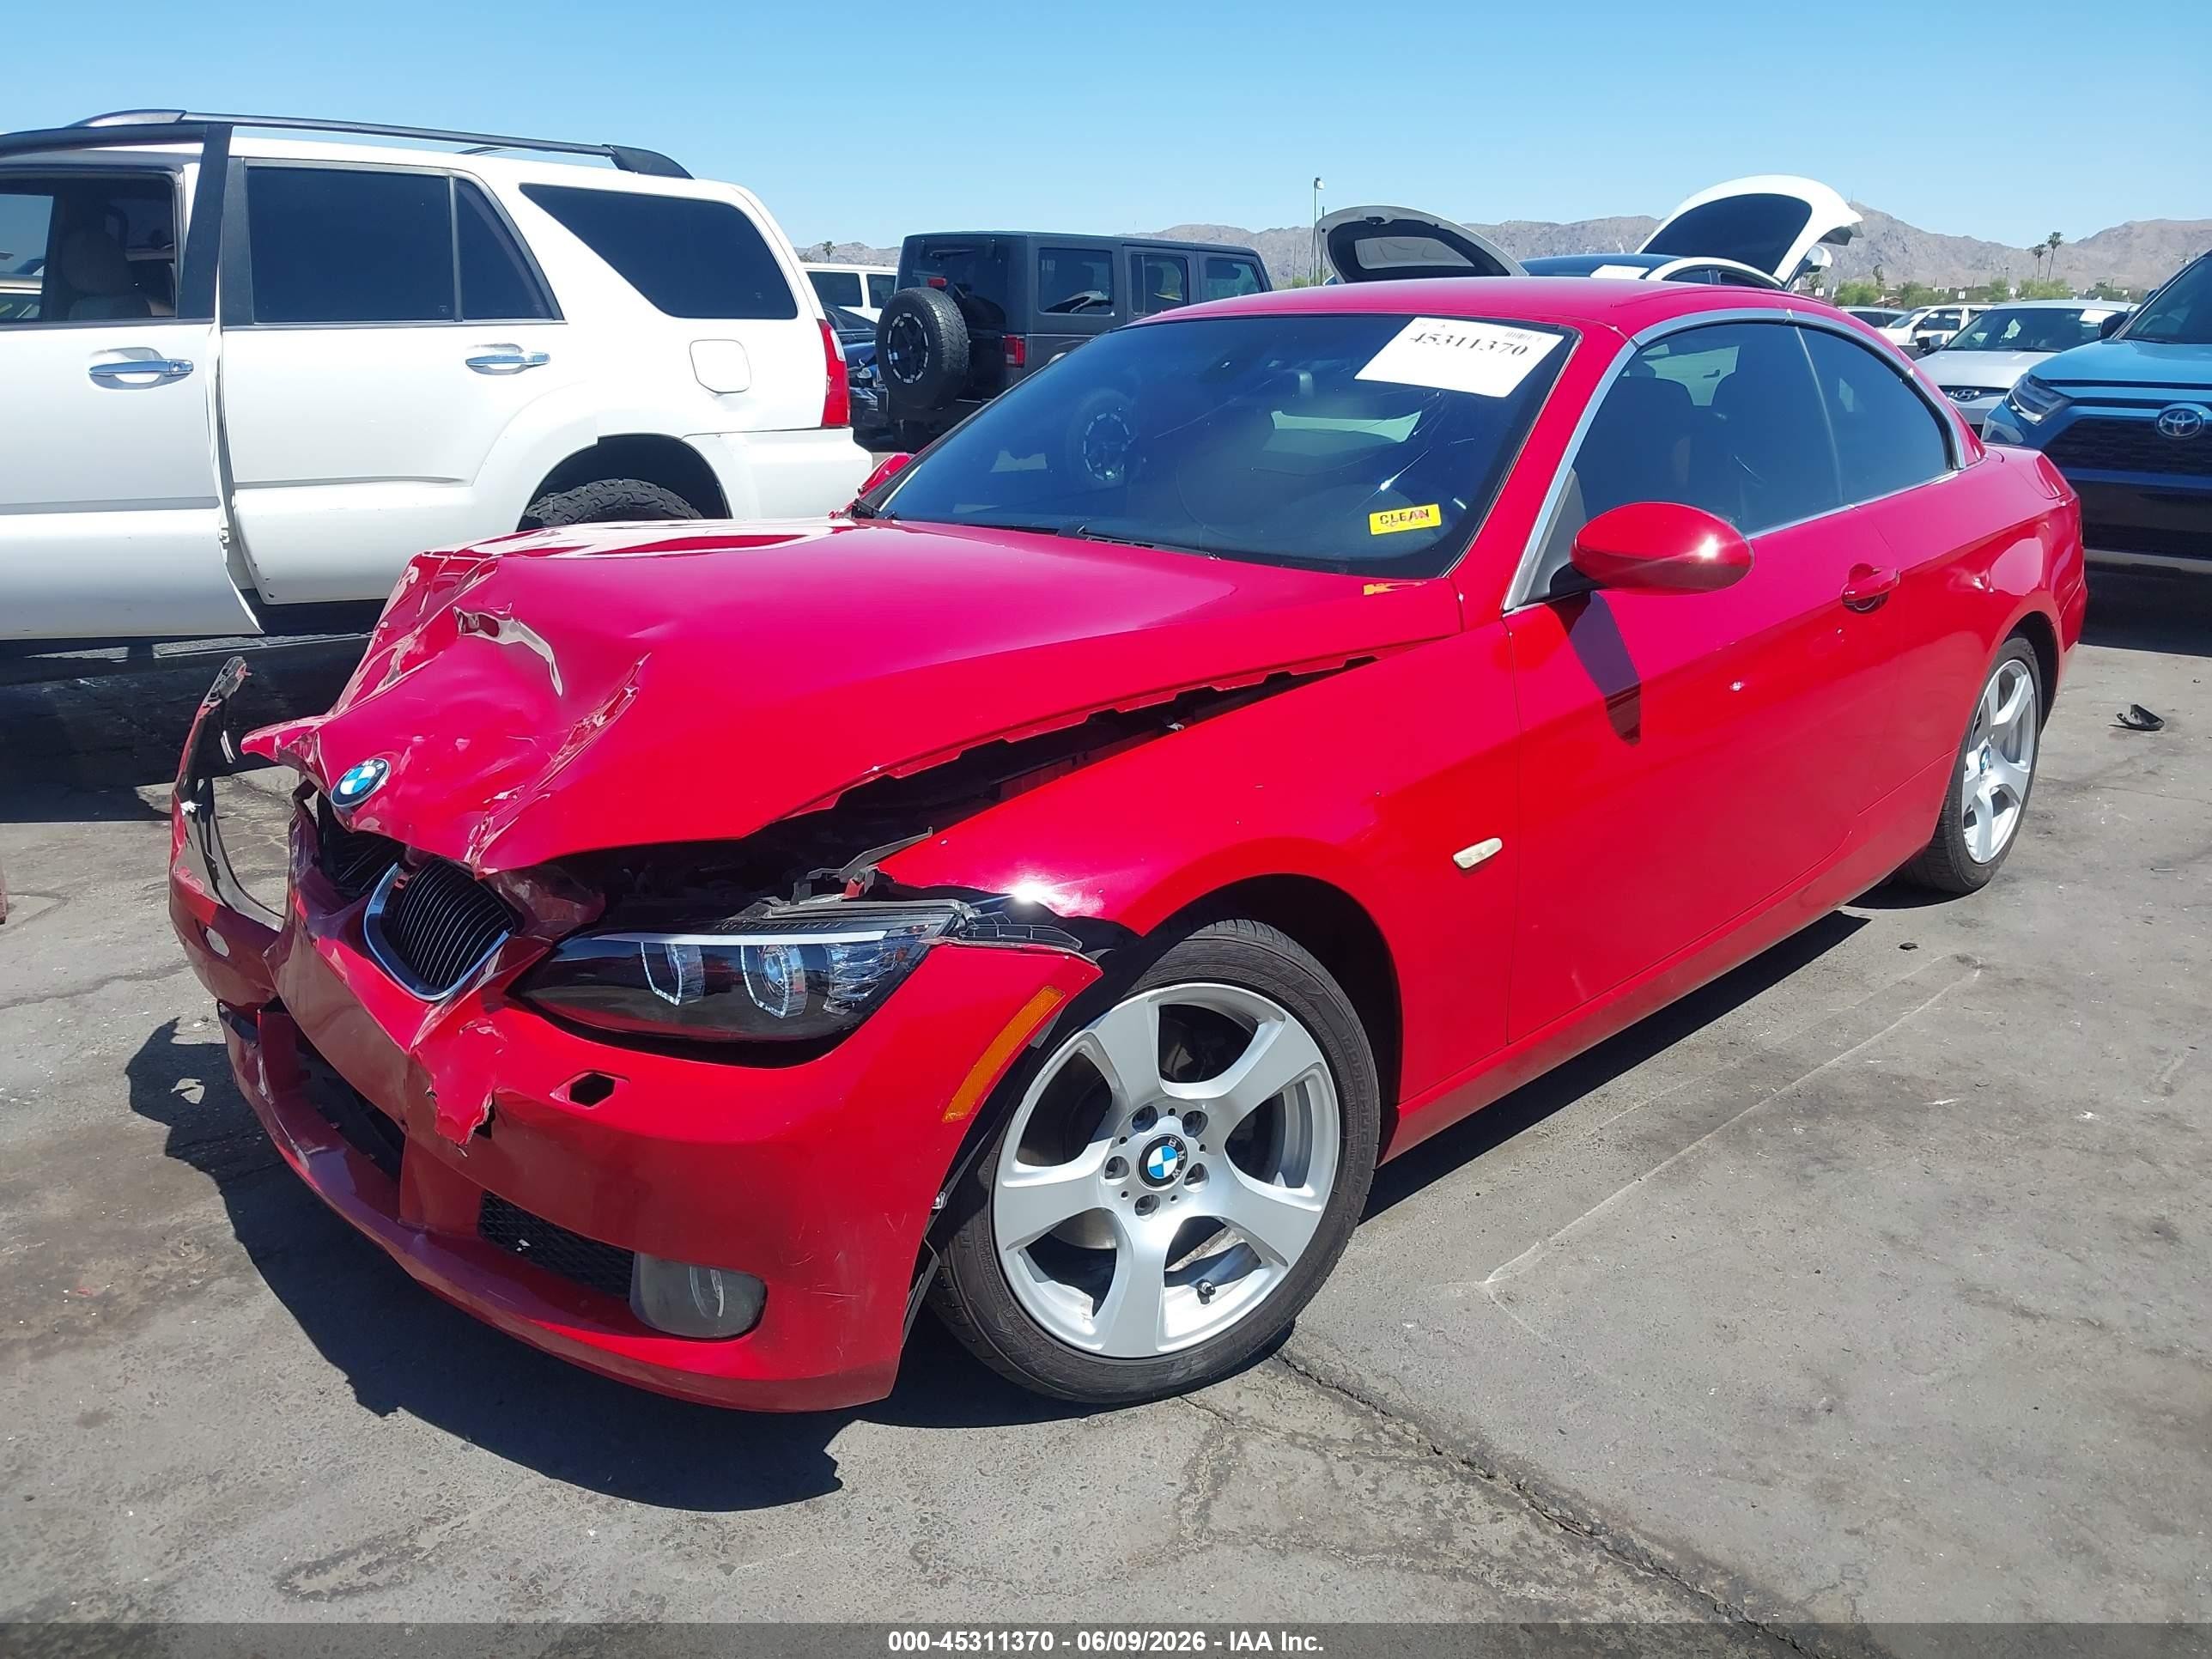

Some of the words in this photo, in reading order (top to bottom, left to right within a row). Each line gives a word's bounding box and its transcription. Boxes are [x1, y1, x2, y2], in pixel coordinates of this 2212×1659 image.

[1410, 332, 1528, 356] 45311370
[1379, 508, 1430, 525] CLEAN
[1168, 1137, 1185, 1179] BMW
